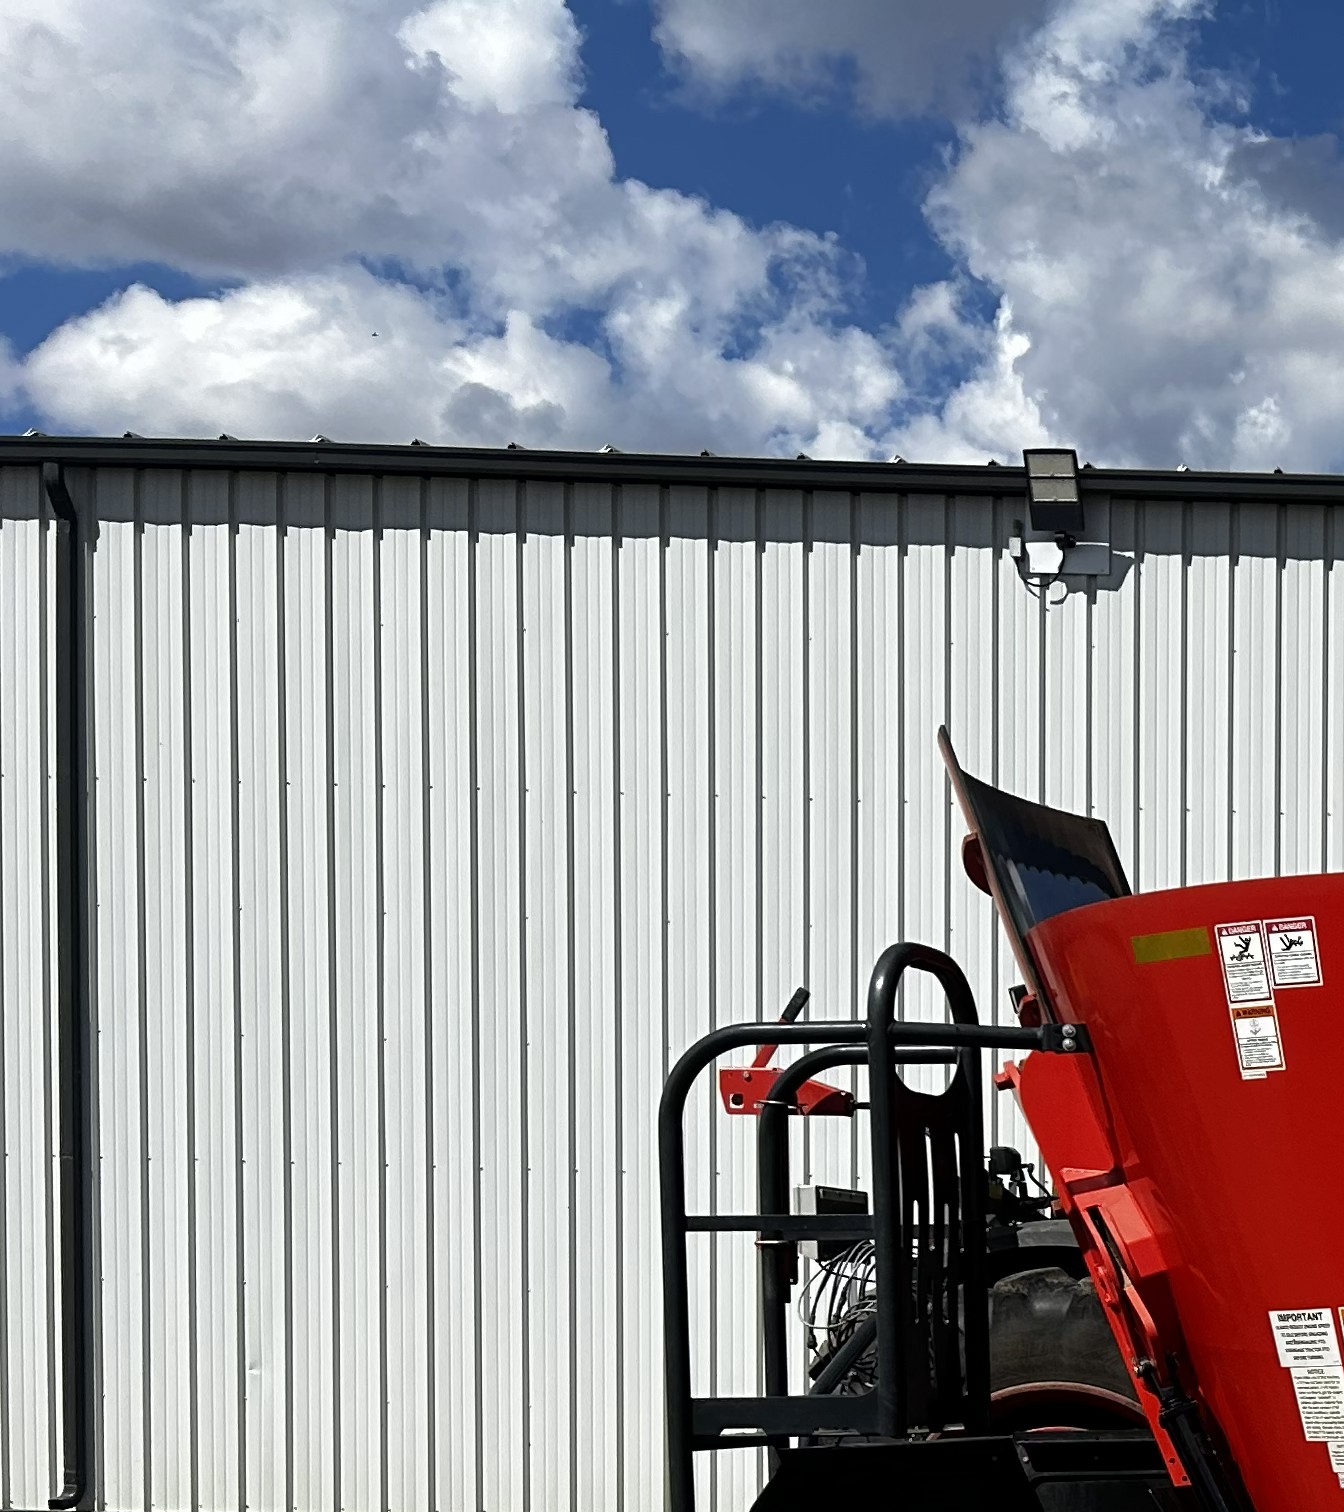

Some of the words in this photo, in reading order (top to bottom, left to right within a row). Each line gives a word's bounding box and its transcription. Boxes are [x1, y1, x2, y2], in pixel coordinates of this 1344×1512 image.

[1228, 925, 1257, 935] DANGER
[1279, 921, 1308, 931] DANGER
[1277, 1312, 1323, 1322] IMPORTANT
